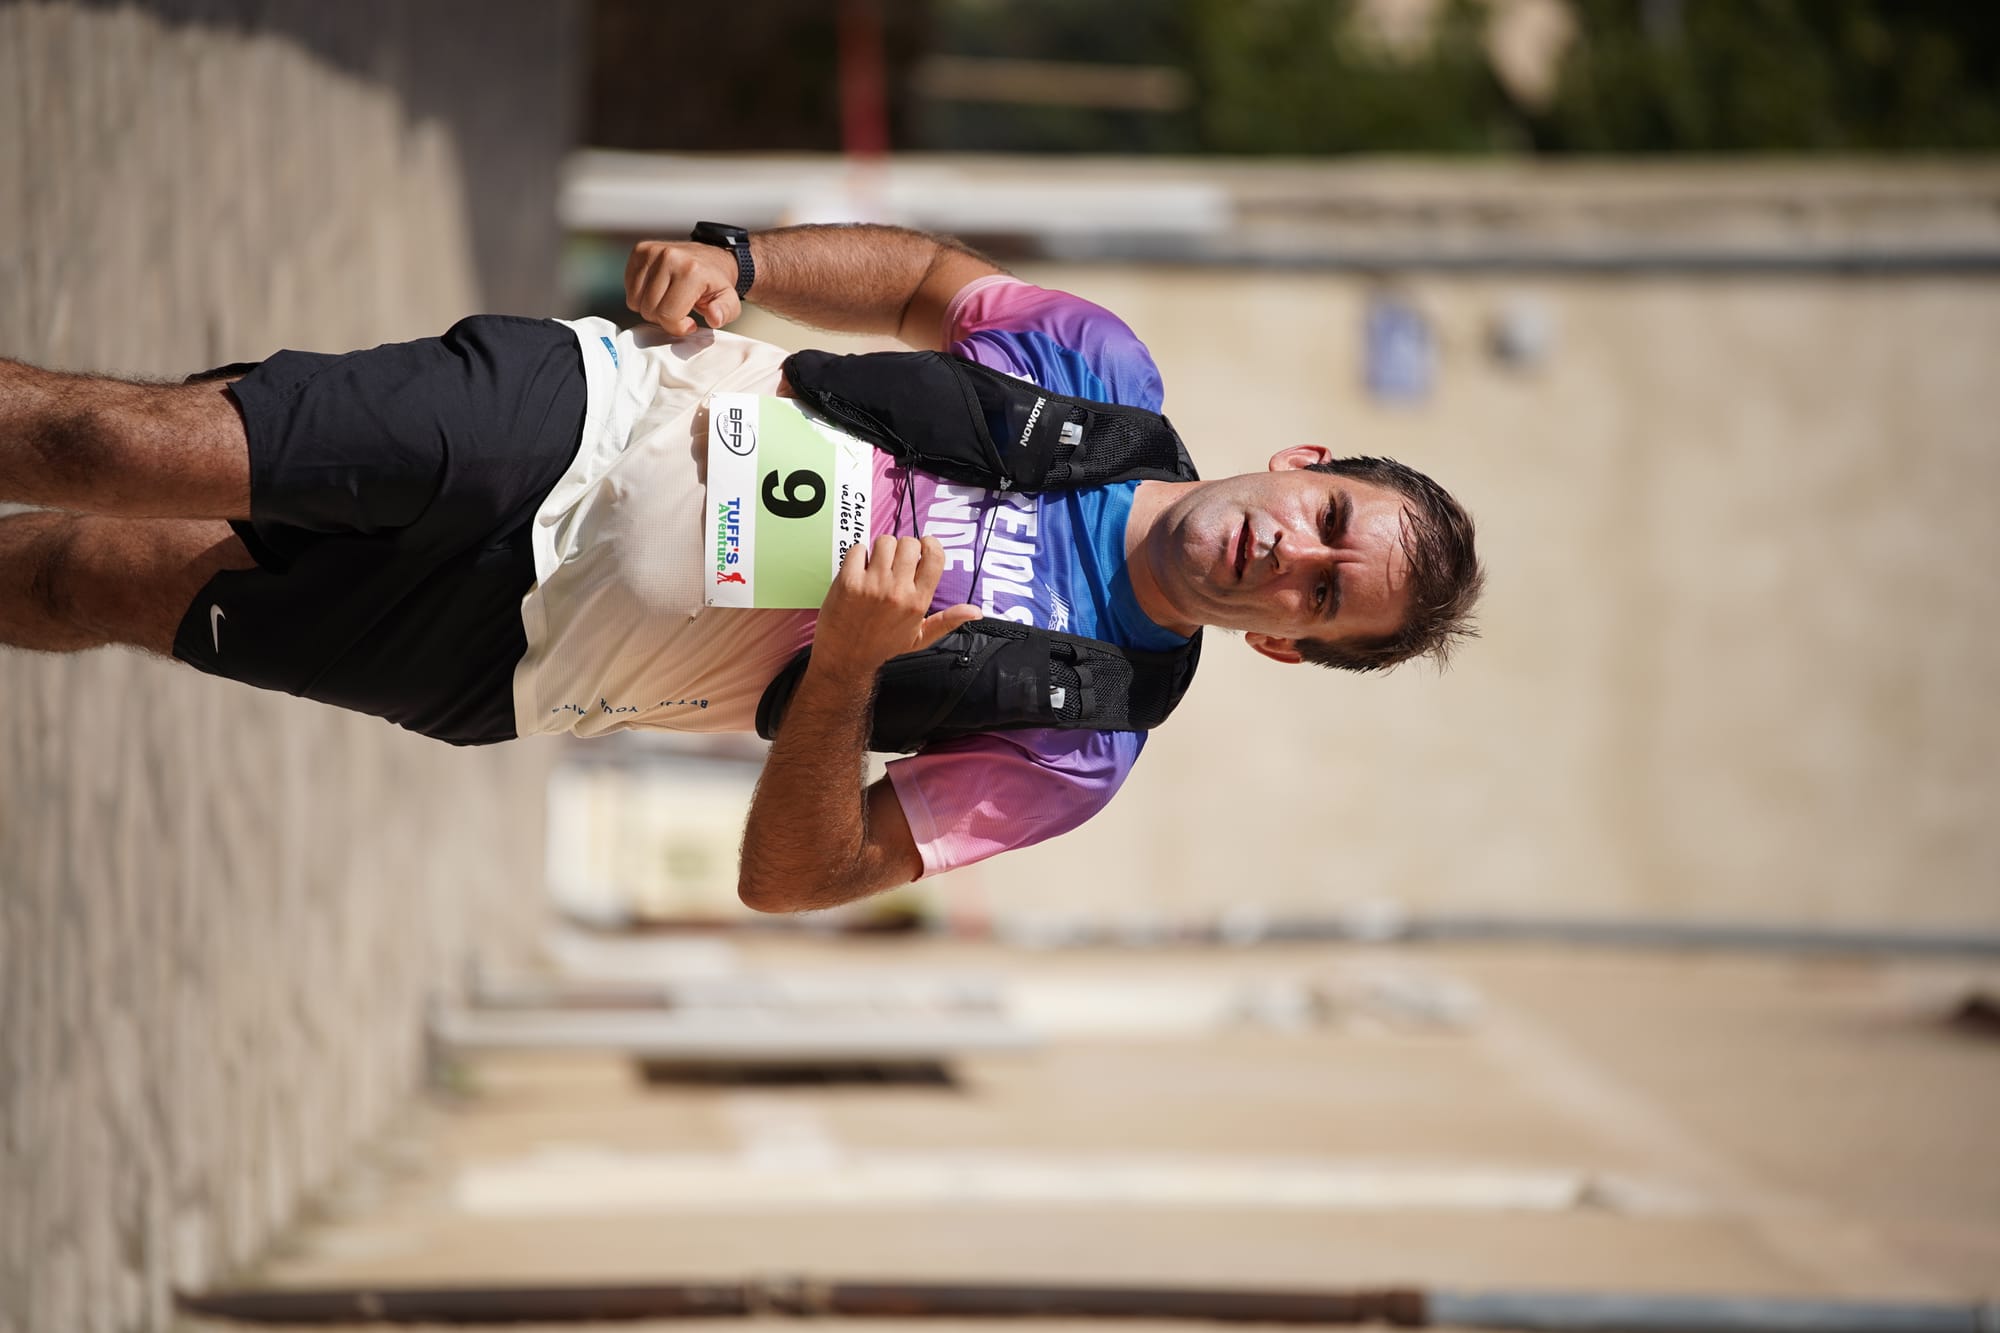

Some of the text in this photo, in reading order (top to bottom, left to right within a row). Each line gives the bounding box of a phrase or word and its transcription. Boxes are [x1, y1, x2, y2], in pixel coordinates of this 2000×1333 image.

[729, 408, 742, 448] BFP
[761, 469, 827, 519] 9
[840, 484, 852, 532] vallées
[852, 491, 867, 547] Challen
[717, 503, 730, 571] Aventure
[726, 497, 740, 564] TUFF'S
[922, 484, 986, 571] NDE
